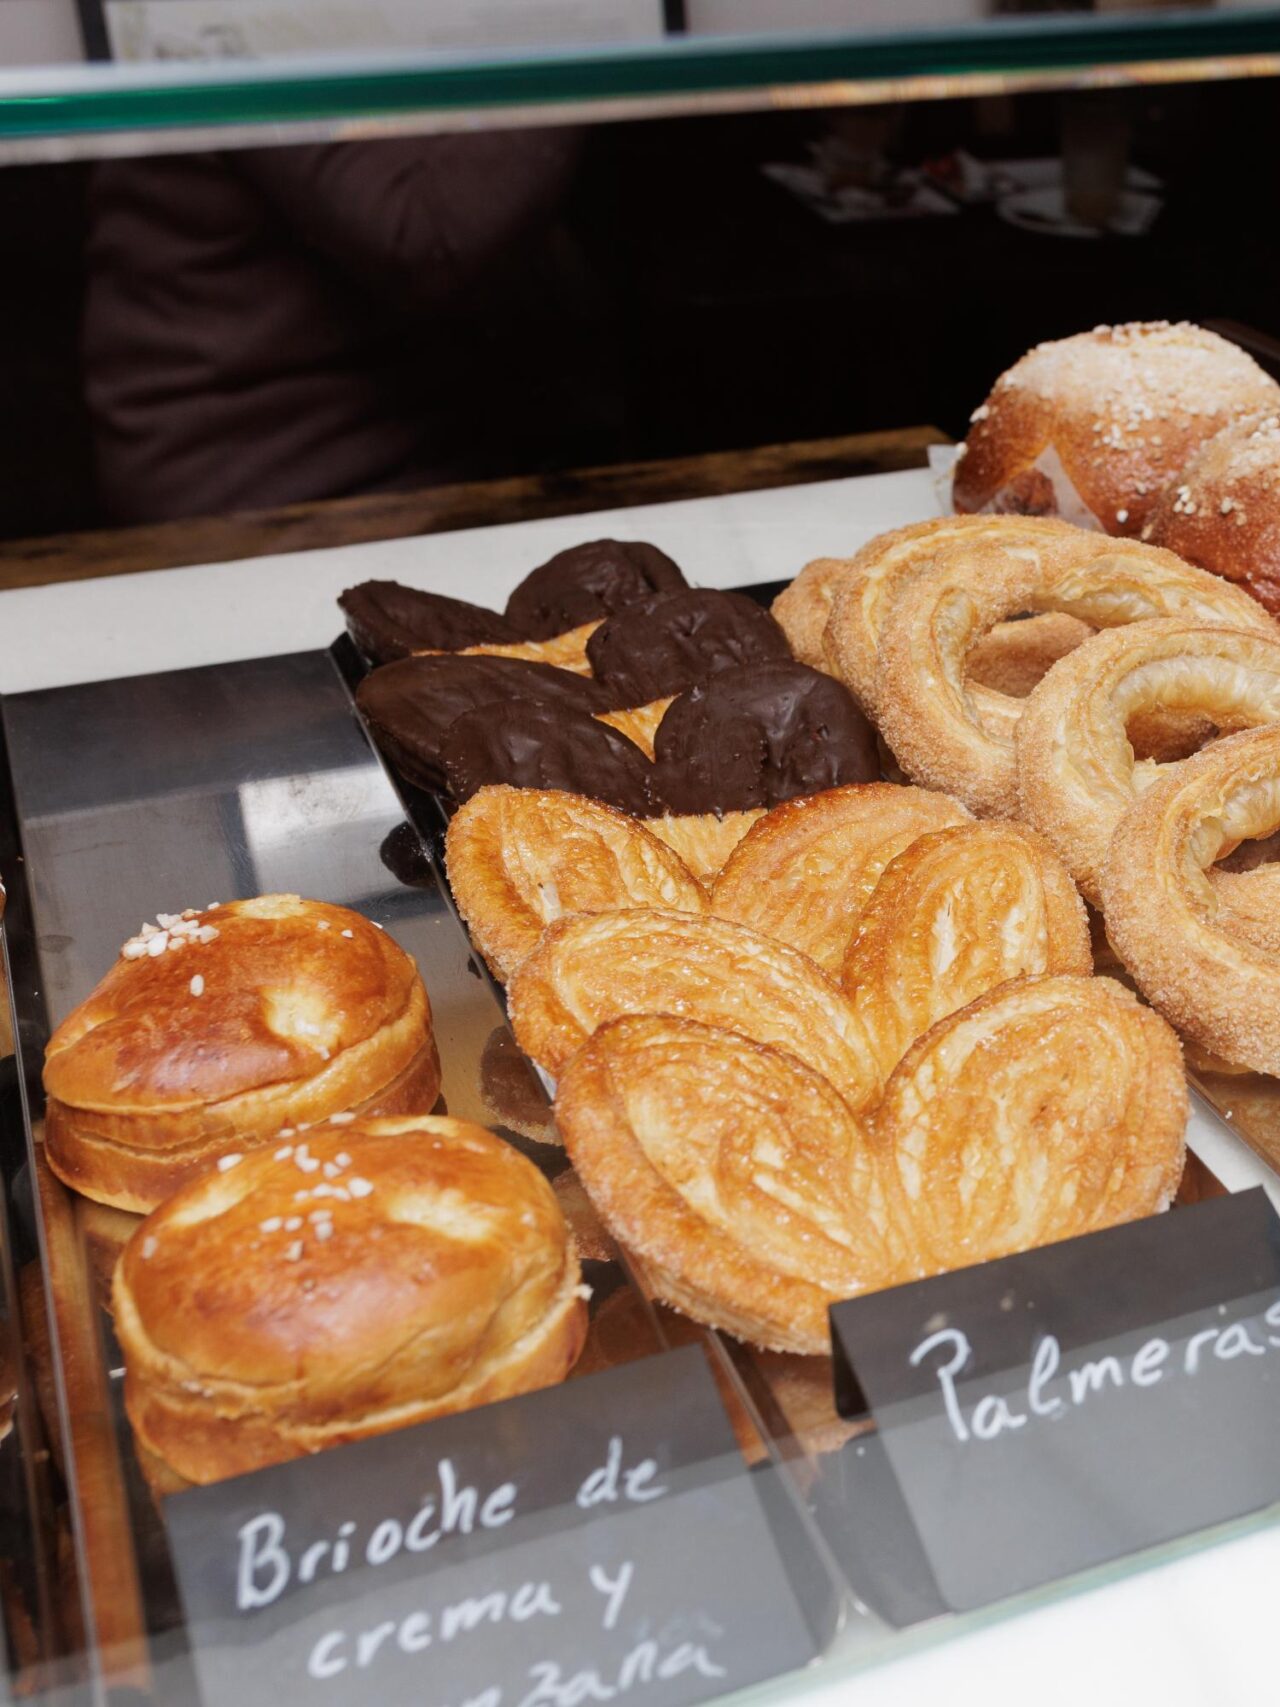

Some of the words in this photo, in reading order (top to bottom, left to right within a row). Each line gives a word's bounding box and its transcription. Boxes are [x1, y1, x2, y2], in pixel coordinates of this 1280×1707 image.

[237, 1458, 518, 1611] Brioche
[577, 1435, 668, 1508] de
[306, 1580, 562, 1680] crema
[589, 1560, 635, 1630] y
